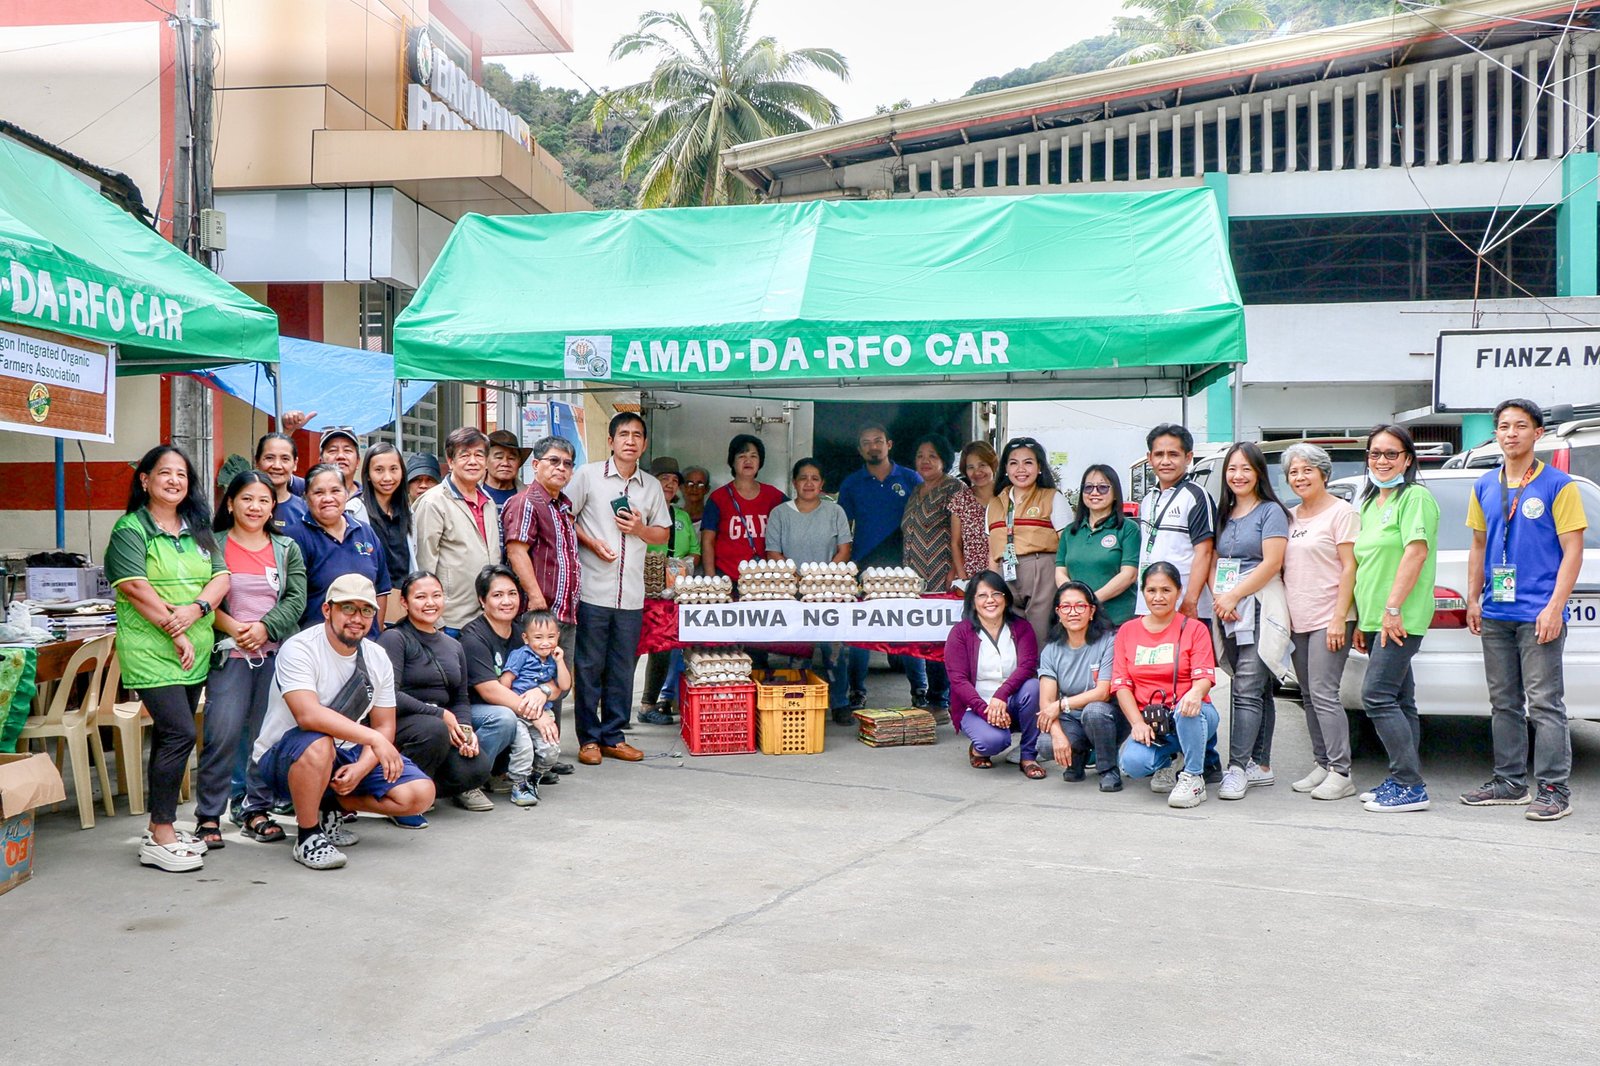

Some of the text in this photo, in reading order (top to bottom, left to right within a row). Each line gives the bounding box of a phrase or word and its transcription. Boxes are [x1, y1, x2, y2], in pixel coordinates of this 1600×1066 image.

[130, 291, 183, 342] CAR
[18, 338, 59, 360] Integrated
[61, 349, 90, 367] Organic
[621, 334, 911, 373] AMAD-DA-RFO
[925, 331, 1009, 366] CAR
[1476, 346, 1600, 368] FIANZA M
[36, 363, 80, 383] Association
[1291, 529, 1308, 539] Lee
[684, 608, 955, 627] KADIWA NG PANGUL
